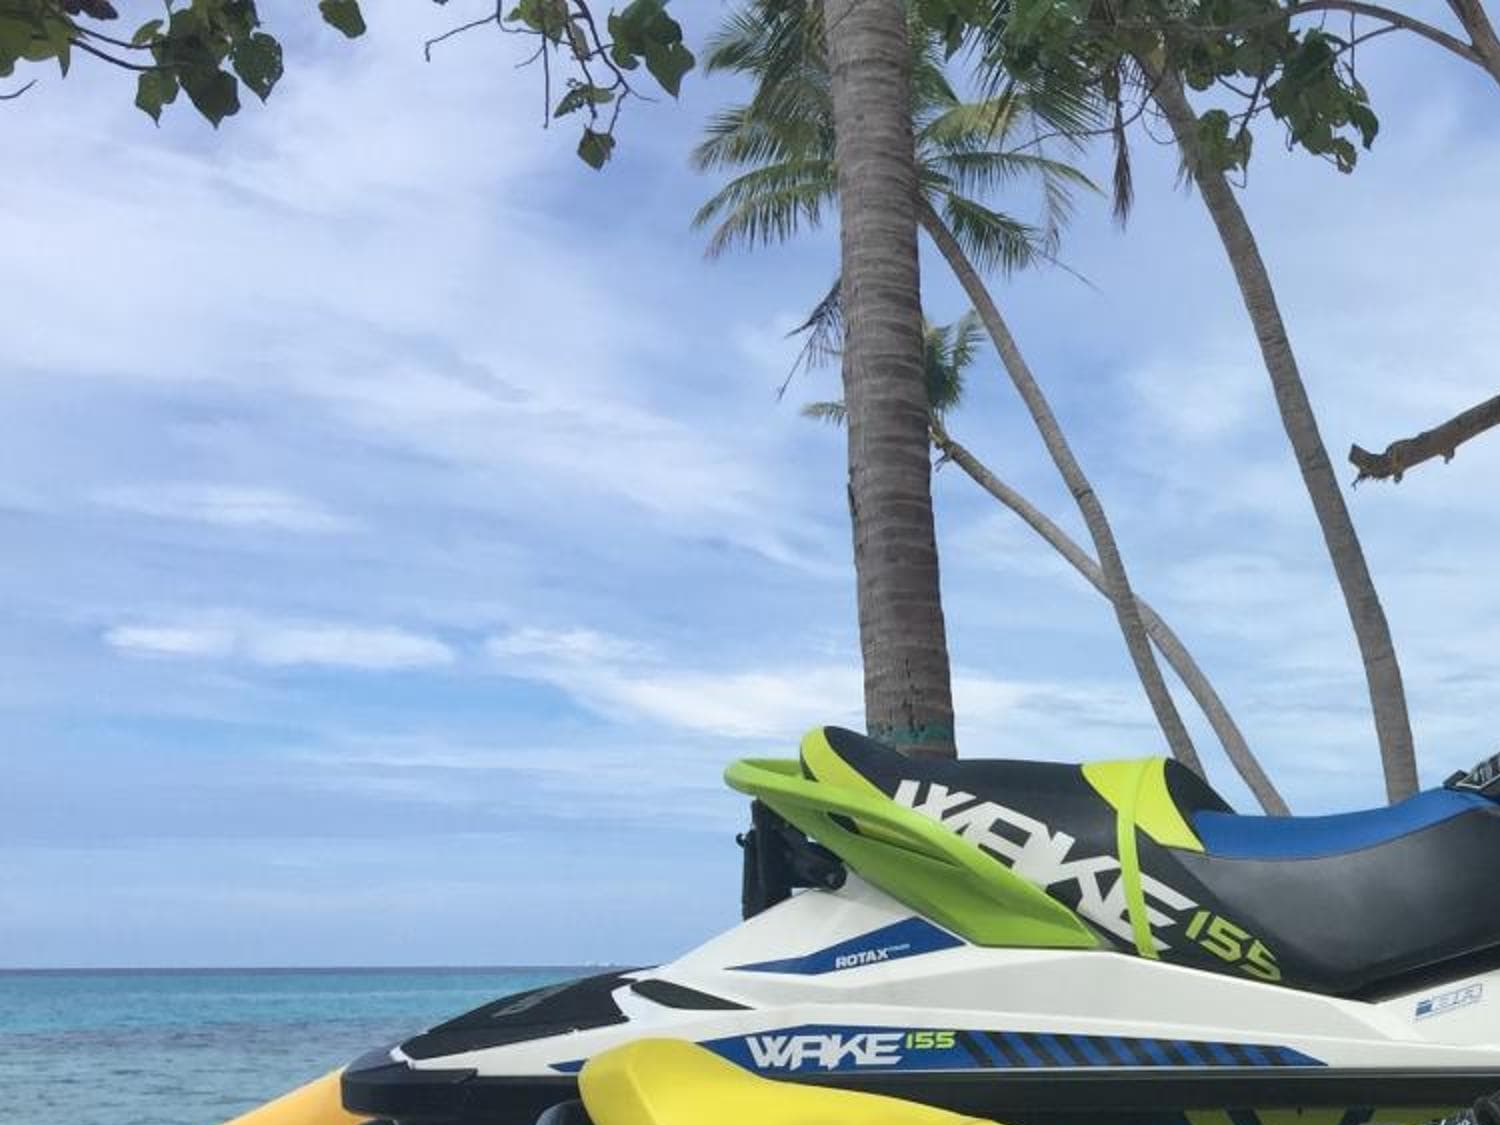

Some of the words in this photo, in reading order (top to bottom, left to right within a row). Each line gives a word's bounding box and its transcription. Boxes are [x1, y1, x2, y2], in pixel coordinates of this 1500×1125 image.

[835, 947, 889, 969] ROTAX
[1185, 910, 1281, 982] 155
[745, 1033, 904, 1071] WAKE
[905, 1031, 957, 1049] 155
